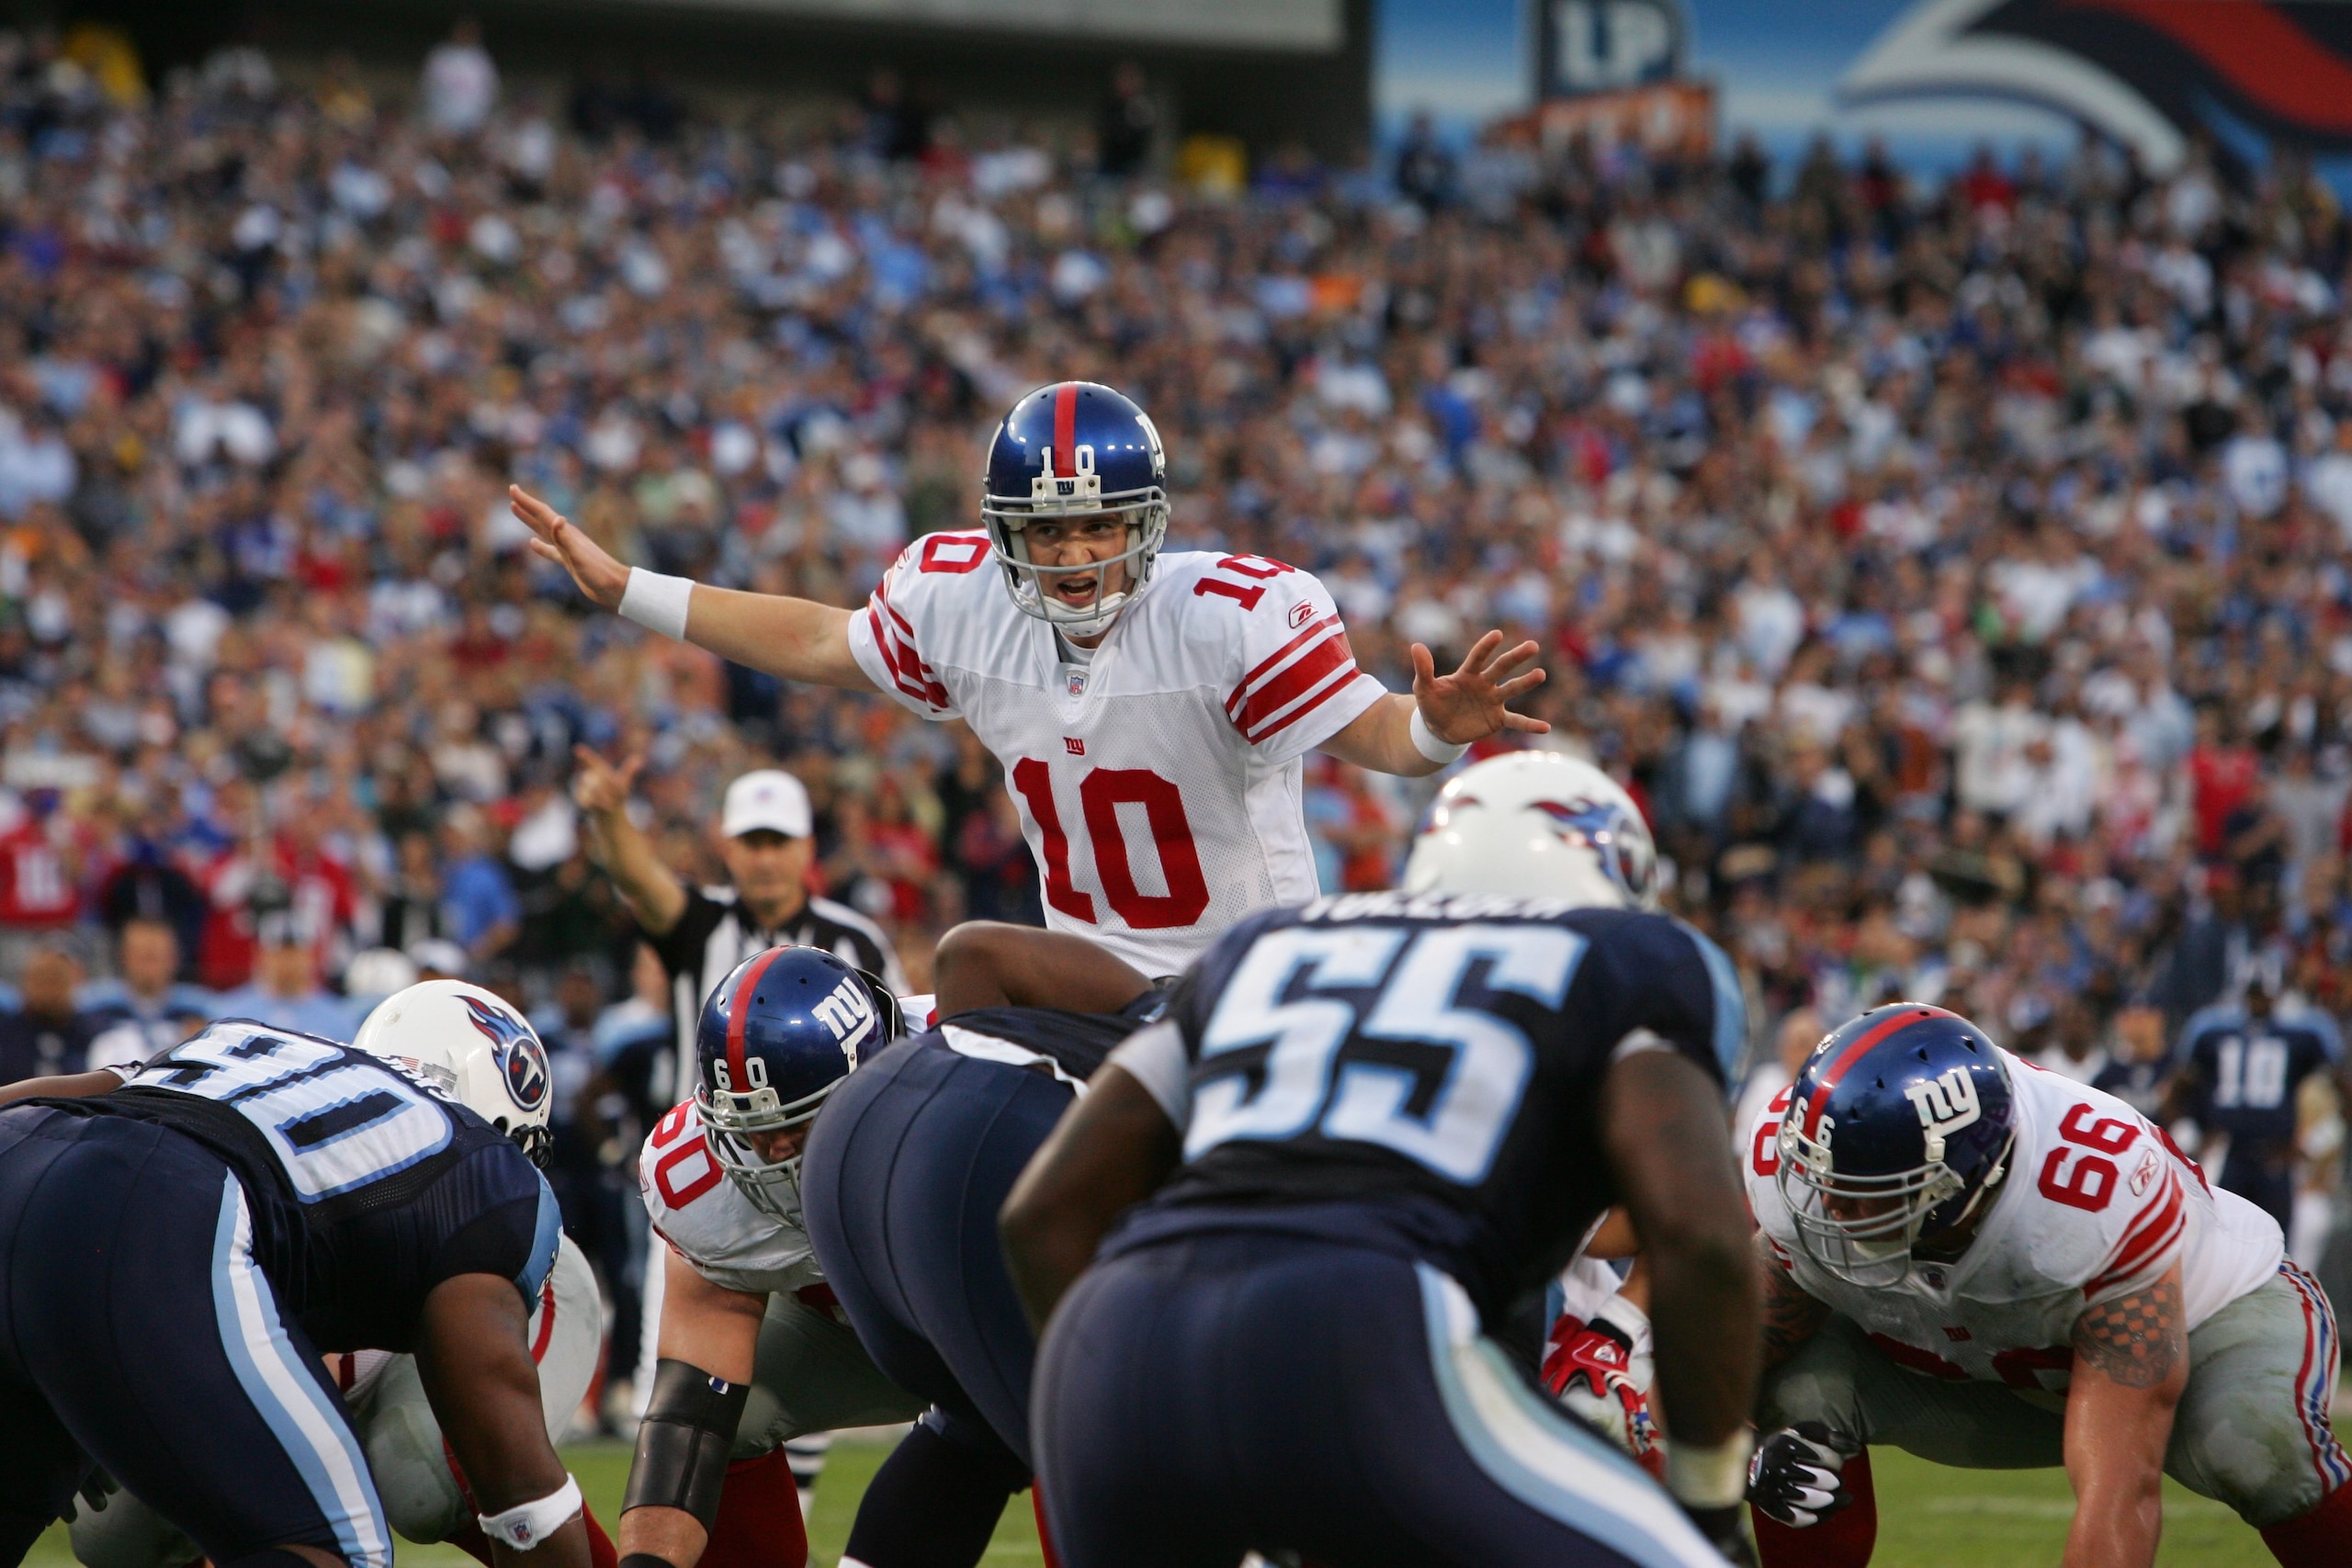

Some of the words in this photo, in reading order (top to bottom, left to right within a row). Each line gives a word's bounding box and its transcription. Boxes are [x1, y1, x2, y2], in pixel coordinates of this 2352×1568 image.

[1041, 444, 1095, 478] 10
[1193, 554, 1295, 612] 10
[1012, 758, 1210, 930] 10
[714, 1056, 768, 1090] 60
[1182, 923, 1590, 1188] 55
[125, 1021, 454, 1205] 90
[1793, 1096, 1836, 1149] 66
[2038, 1103, 2142, 1213] 66
